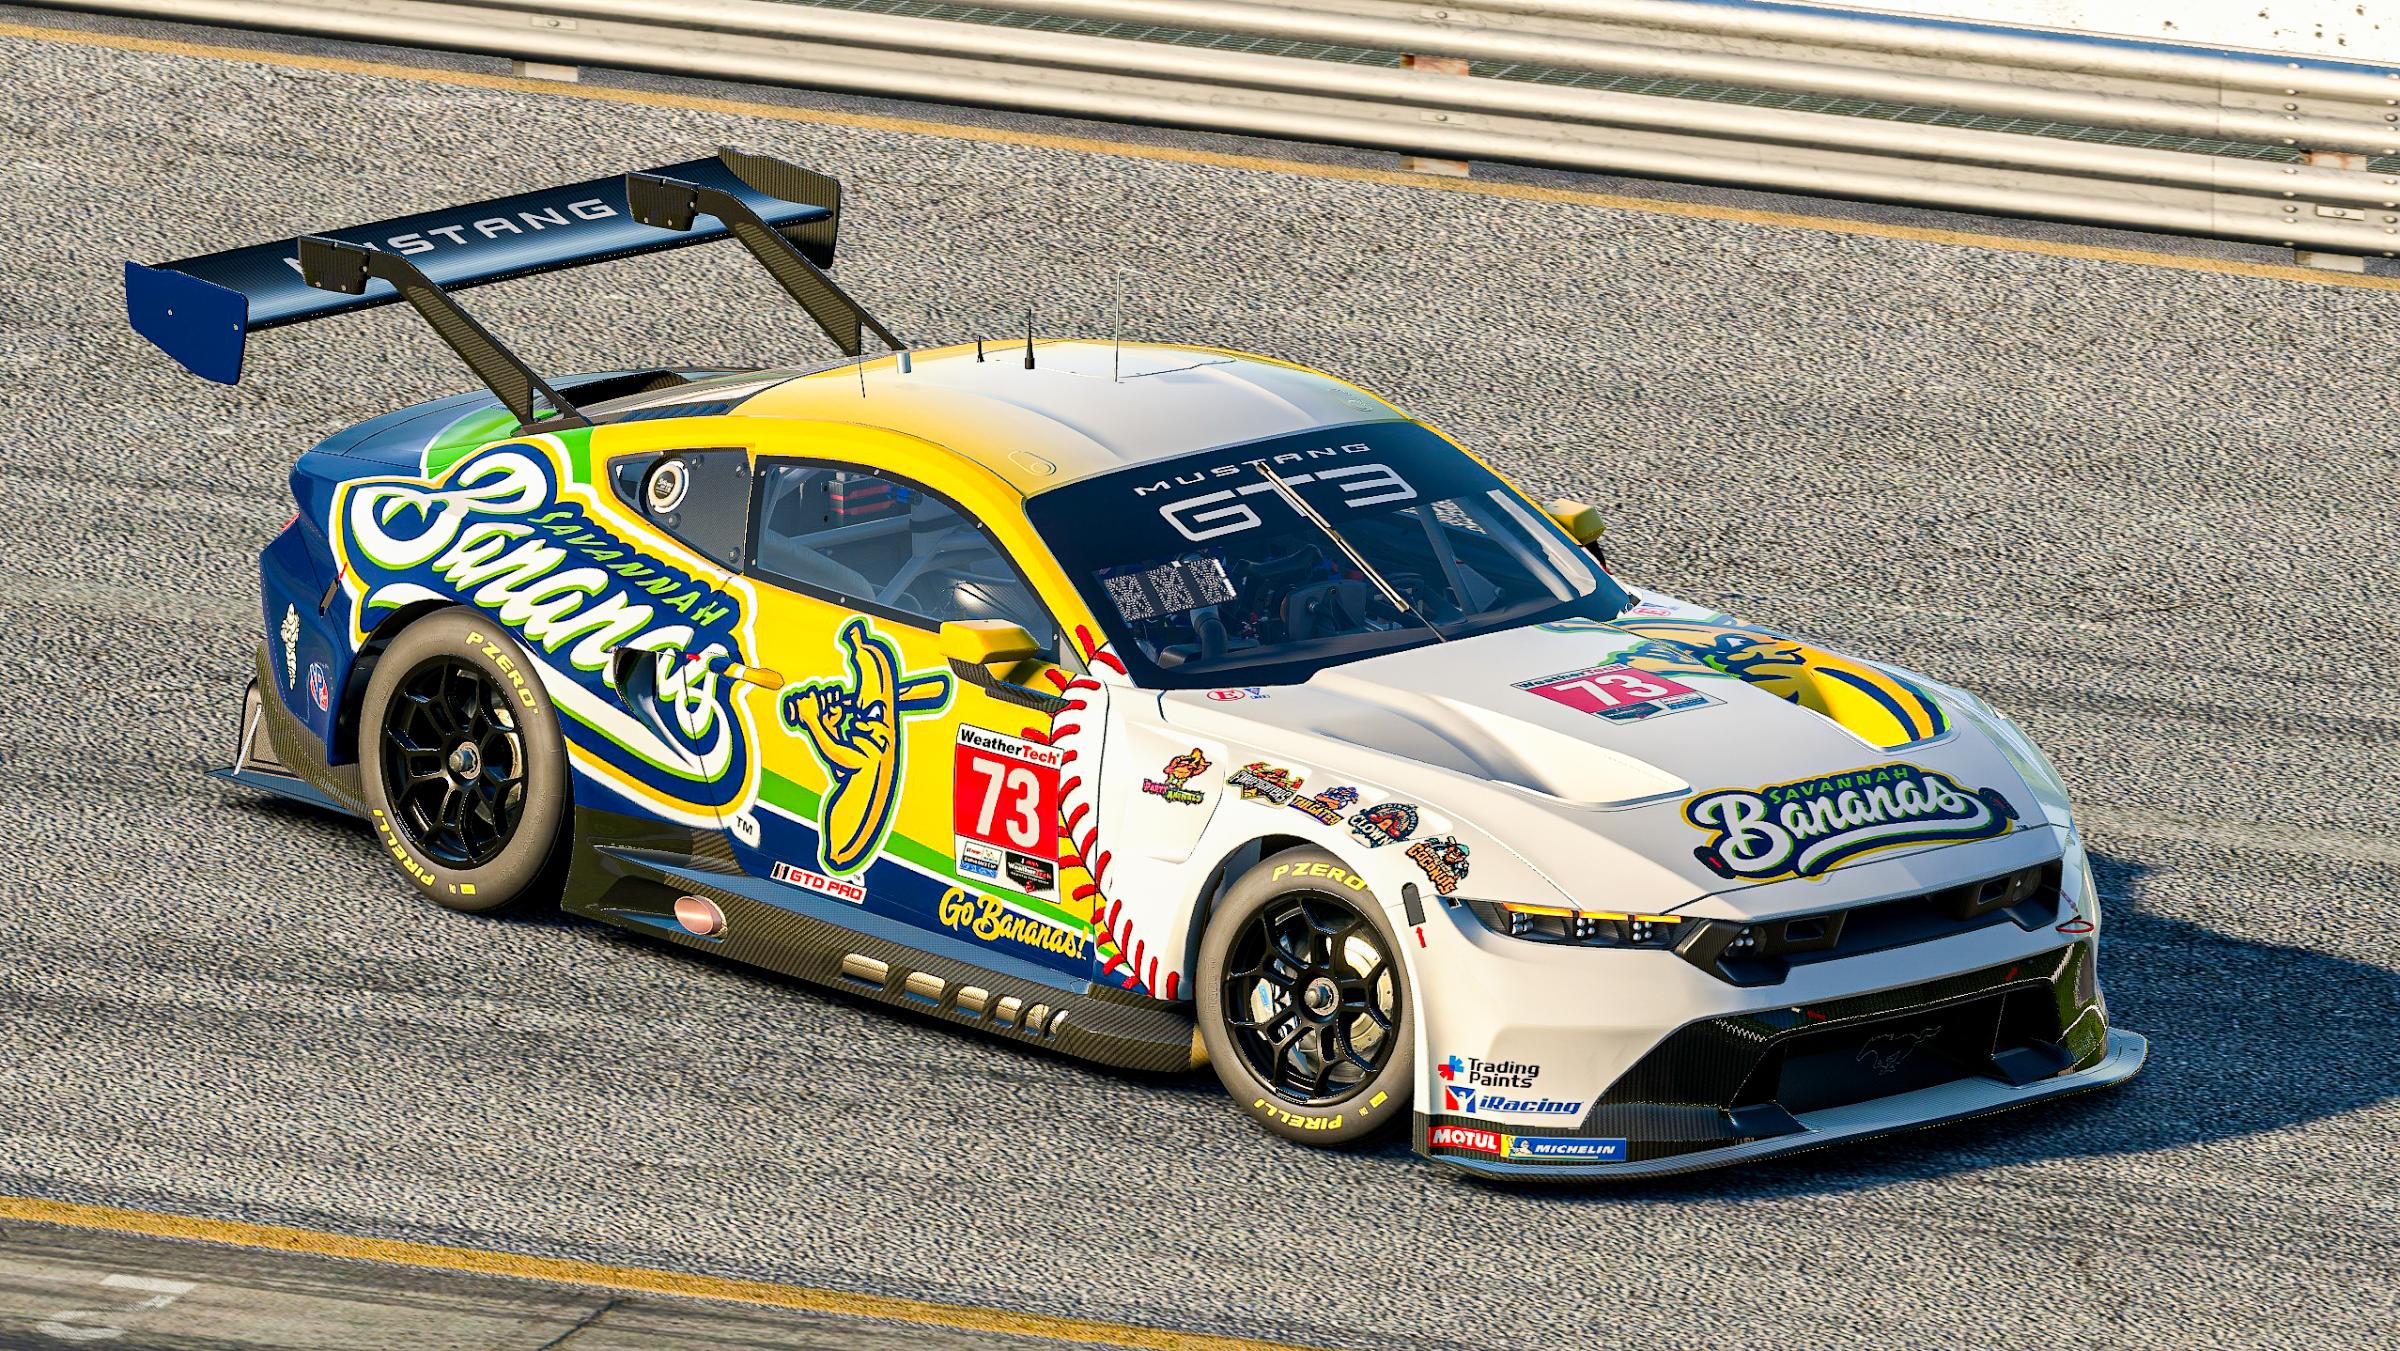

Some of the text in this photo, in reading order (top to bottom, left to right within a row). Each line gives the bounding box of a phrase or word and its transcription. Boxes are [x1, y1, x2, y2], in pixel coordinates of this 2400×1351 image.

[1133, 442, 1372, 496] MUSTANG
[1159, 463, 1418, 542] GT3
[527, 510, 729, 627] SAVANNAH
[350, 452, 733, 783] Bananas
[1517, 664, 1624, 690] WeatherTech
[1552, 674, 1669, 707] 73
[960, 728, 1058, 766] WeatherTech
[972, 756, 1040, 848] 73
[1769, 767, 1909, 805] SAVANNAH
[734, 815, 754, 836] TM
[1694, 776, 1992, 874] Bananas
[372, 809, 436, 887] PIRELLI
[789, 869, 863, 901] GTD PRO
[938, 886, 1089, 959] Go Bananas!
[1468, 1057, 1540, 1078] Trading
[1469, 1072, 1533, 1088] Paints
[1253, 1099, 1344, 1131] PIRELLI
[1479, 1095, 1583, 1114] iRacing
[1432, 1128, 1498, 1151] MOTUL
[1534, 1144, 1616, 1155] MICHELIN
